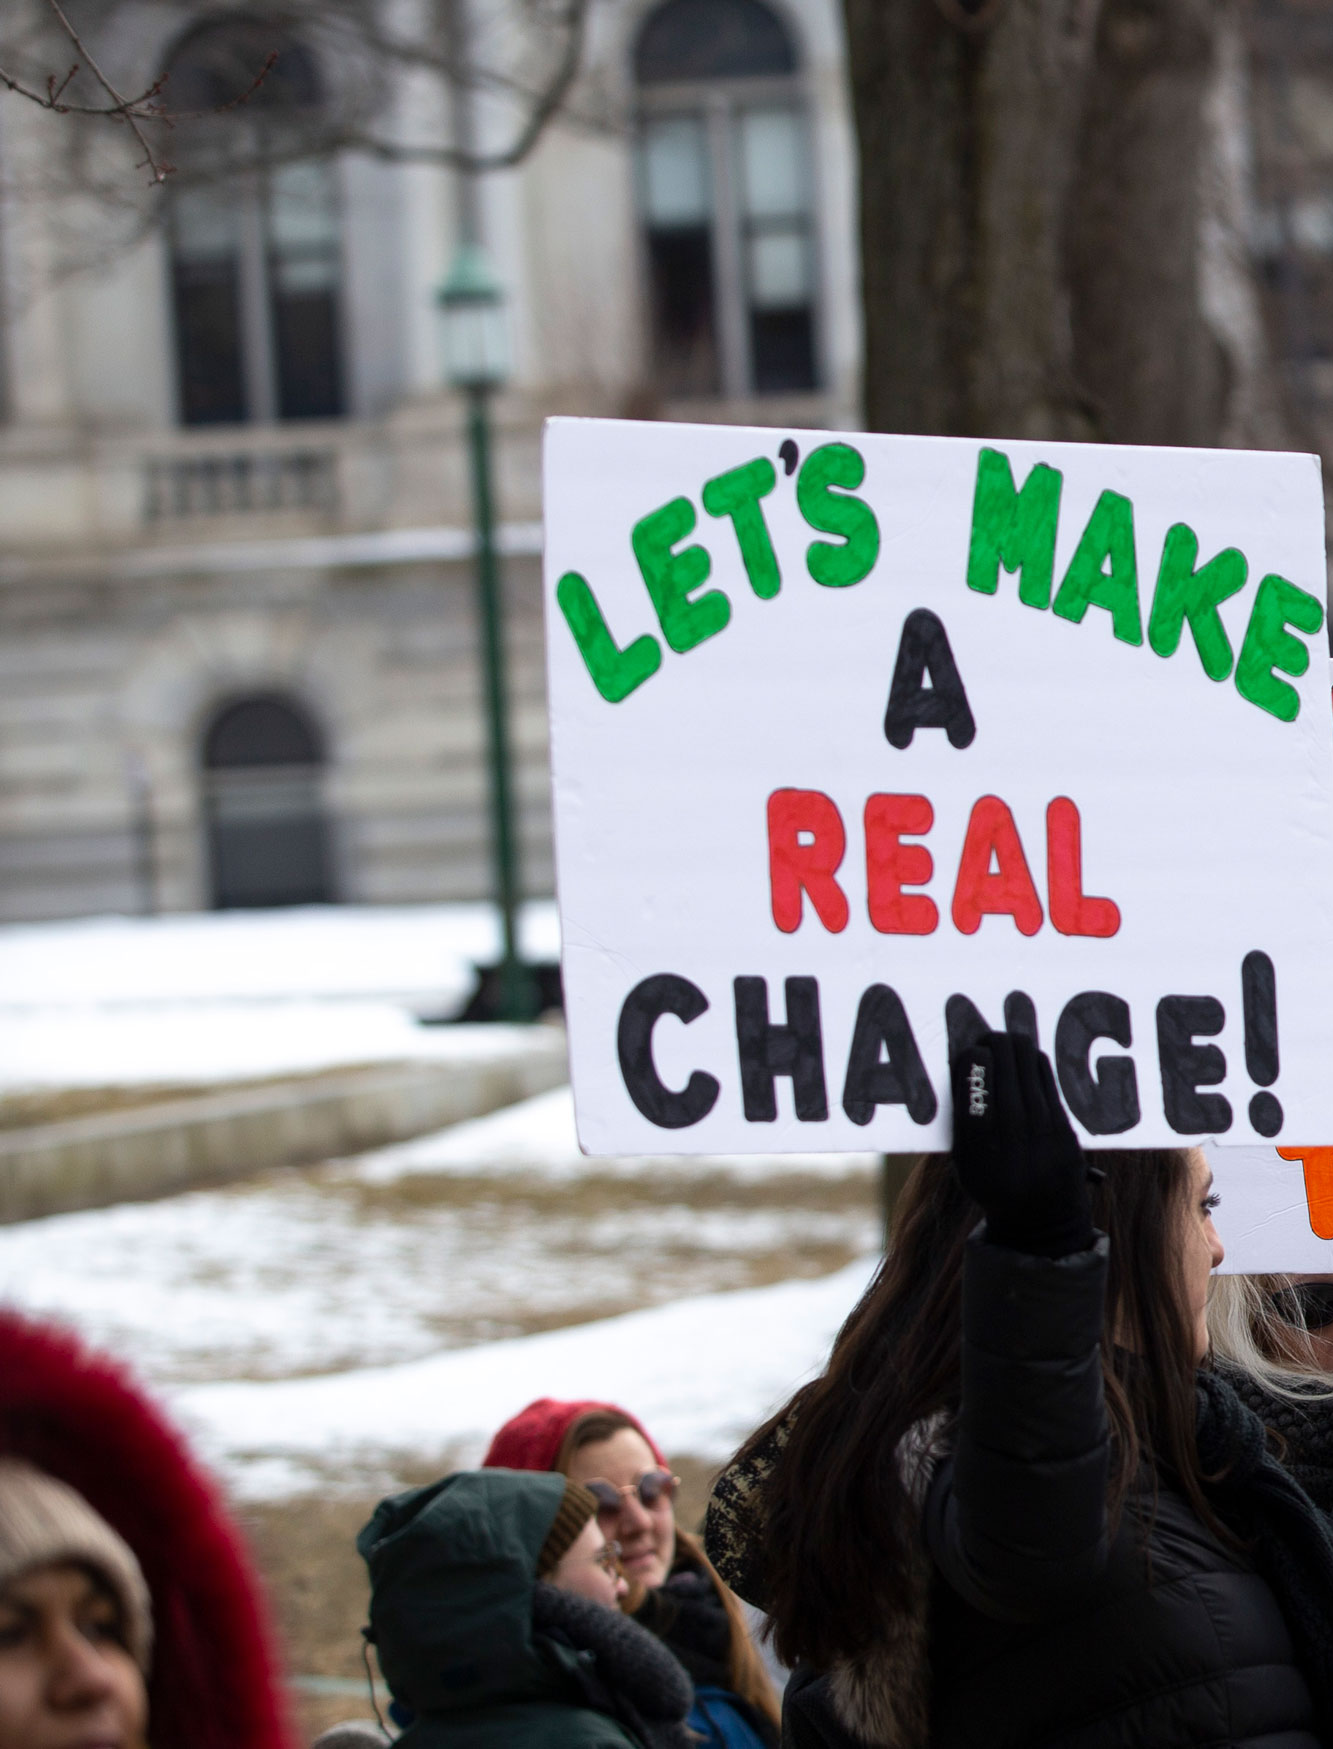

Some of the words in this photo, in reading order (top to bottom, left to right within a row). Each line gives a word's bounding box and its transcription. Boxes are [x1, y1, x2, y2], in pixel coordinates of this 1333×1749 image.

[556, 439, 880, 704] LET'S
[965, 446, 1324, 723] MAKE
[883, 607, 977, 750] A
[766, 787, 1122, 938] REAL
